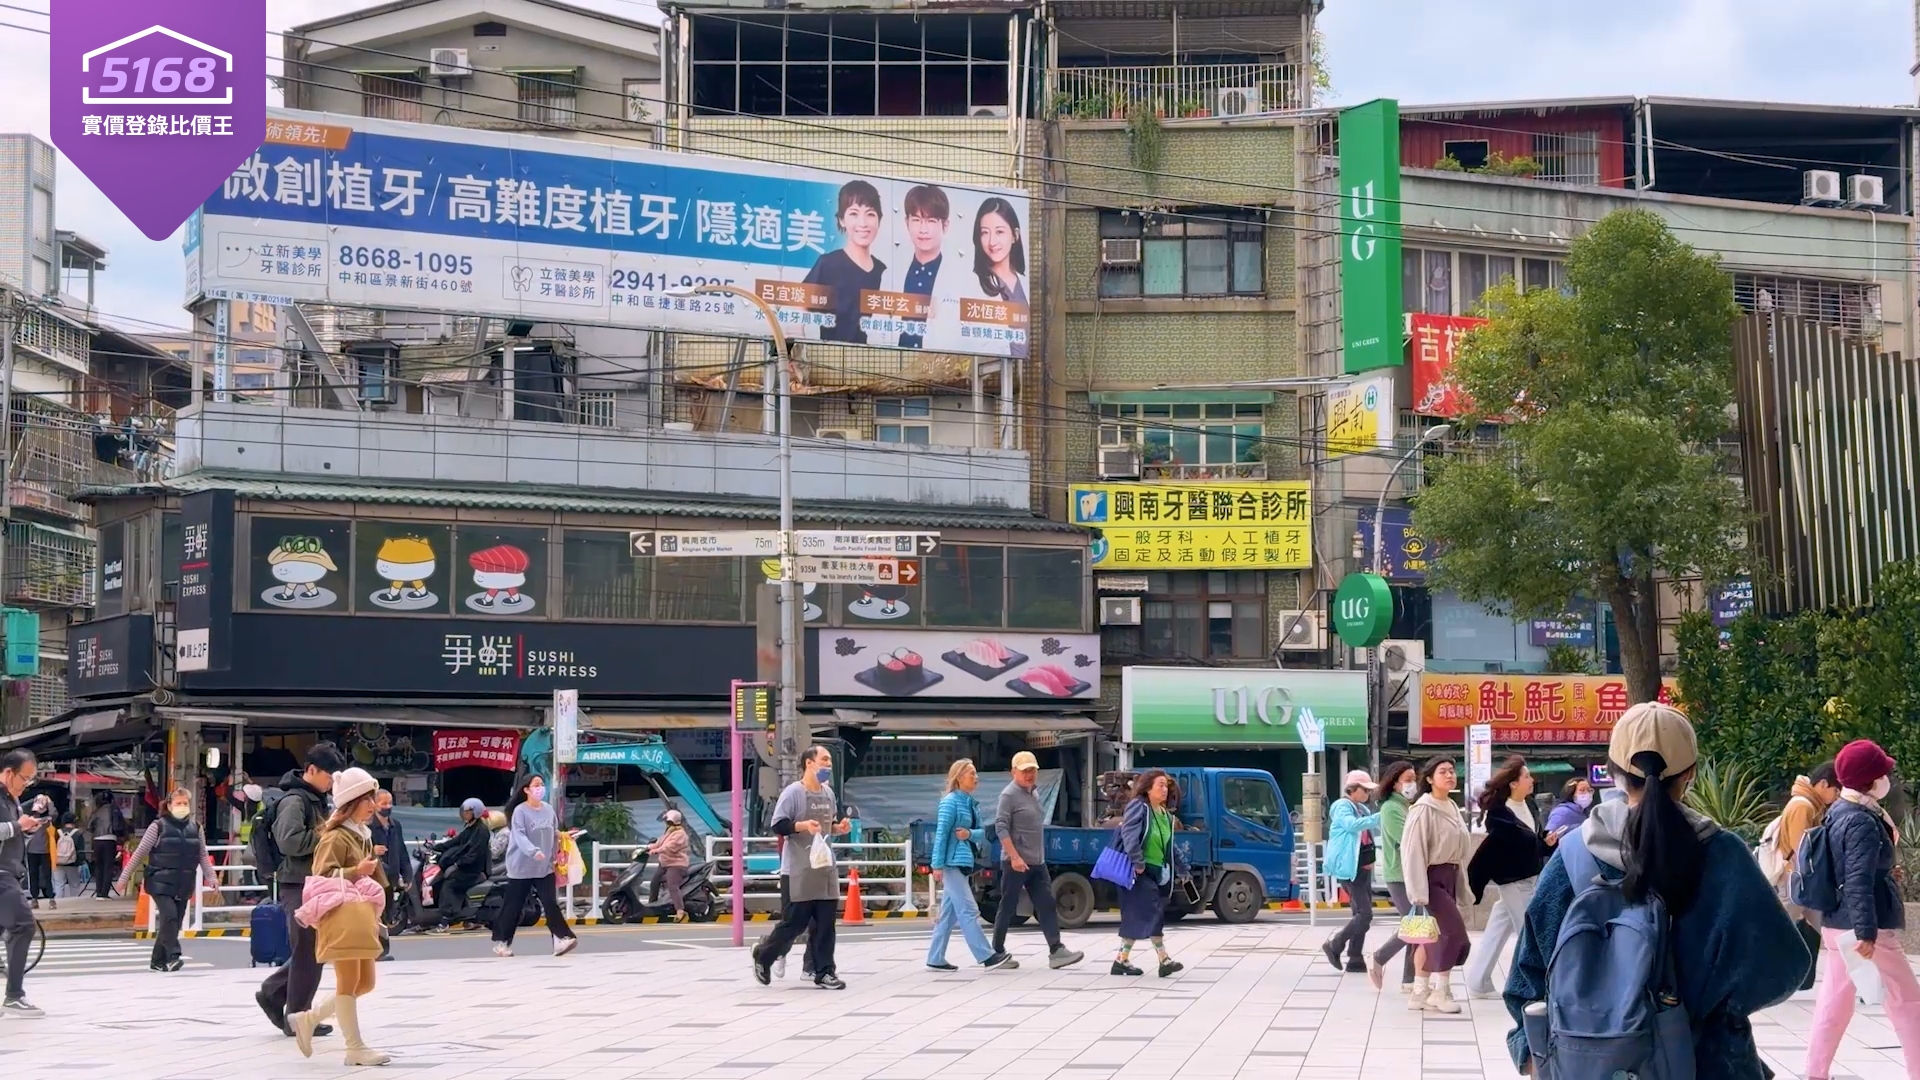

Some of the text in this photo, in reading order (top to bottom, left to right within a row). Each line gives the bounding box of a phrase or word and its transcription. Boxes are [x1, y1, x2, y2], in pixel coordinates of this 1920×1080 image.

[260, 243, 322, 261] 立新美學
[339, 245, 473, 275] 8668-1095
[260, 259, 322, 277] 牙醫診所
[540, 266, 595, 283] 立薇美學
[338, 270, 473, 293] 中和區景新街460號
[540, 282, 595, 300] 牙醫診所
[612, 293, 735, 315] 中和區捷運路25號
[867, 294, 910, 313] 李世玄
[755, 308, 836, 326] 水射牙周專家
[861, 318, 927, 335] 微創植牙專家
[1114, 490, 1307, 521] 興南牙醫聯合診所
[754, 537, 772, 548] 75m
[802, 536, 825, 548] 535m
[1114, 548, 1301, 563] 固定及活動假牙製作
[800, 565, 817, 574] 935M
[182, 573, 199, 585] SUSHI
[182, 585, 207, 598] EXPRESS
[99, 649, 113, 661] SUSHI
[527, 650, 574, 663] SUSHI
[98, 663, 119, 676] EXPRESS
[527, 664, 598, 678] EXPRESS
[582, 751, 626, 761] AIRMAN
